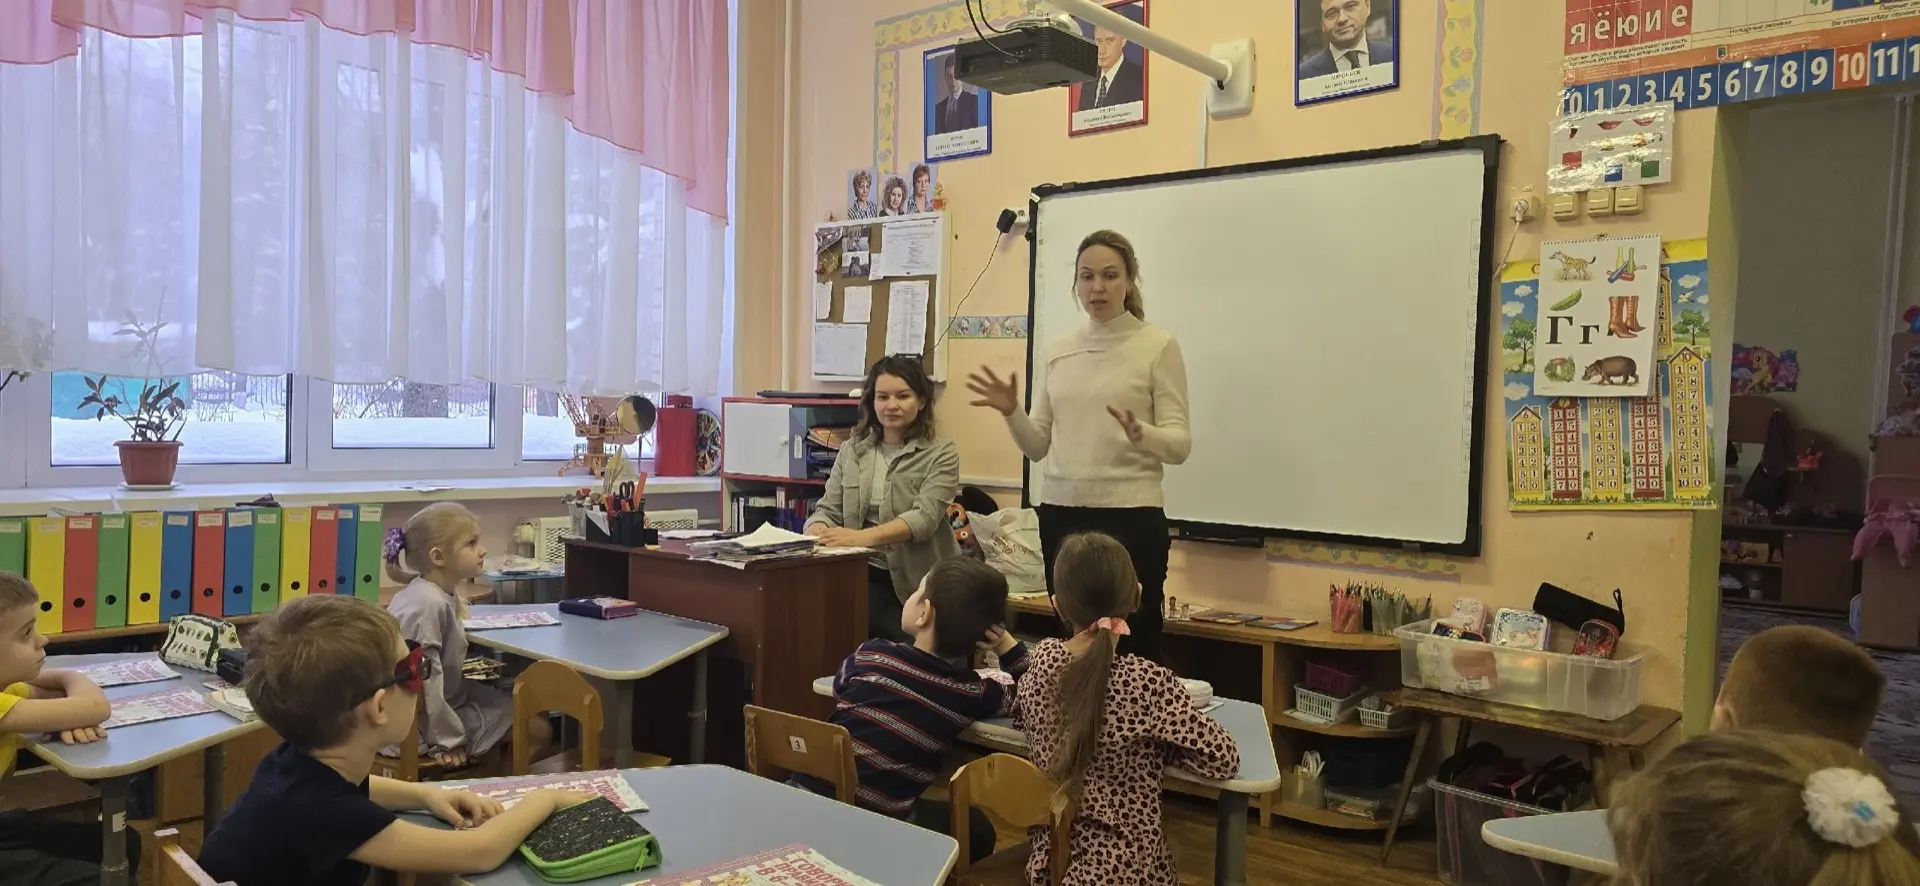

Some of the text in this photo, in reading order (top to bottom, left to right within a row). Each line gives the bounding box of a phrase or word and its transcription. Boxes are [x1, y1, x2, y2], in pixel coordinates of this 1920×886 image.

[1569, 4, 1688, 45] я ё ю и е
[1570, 44, 1920, 116] 0 1 2 3 4 5 6 7 8 9 10 11 1
[1546, 316, 1600, 344] Г г
[1680, 353, 1691, 362] 10
[1676, 378, 1684, 386] 2
[1678, 390, 1696, 400] 3 7
[1677, 404, 1684, 412] 4
[1678, 416, 1698, 425] 5 5
[1678, 428, 1698, 437] 6 4
[1680, 440, 1699, 449] 7 3
[1692, 453, 1700, 462] 2
[1680, 466, 1698, 474] 9 1
[1678, 478, 1701, 487] 10 0
[796, 740, 800, 749] 3
